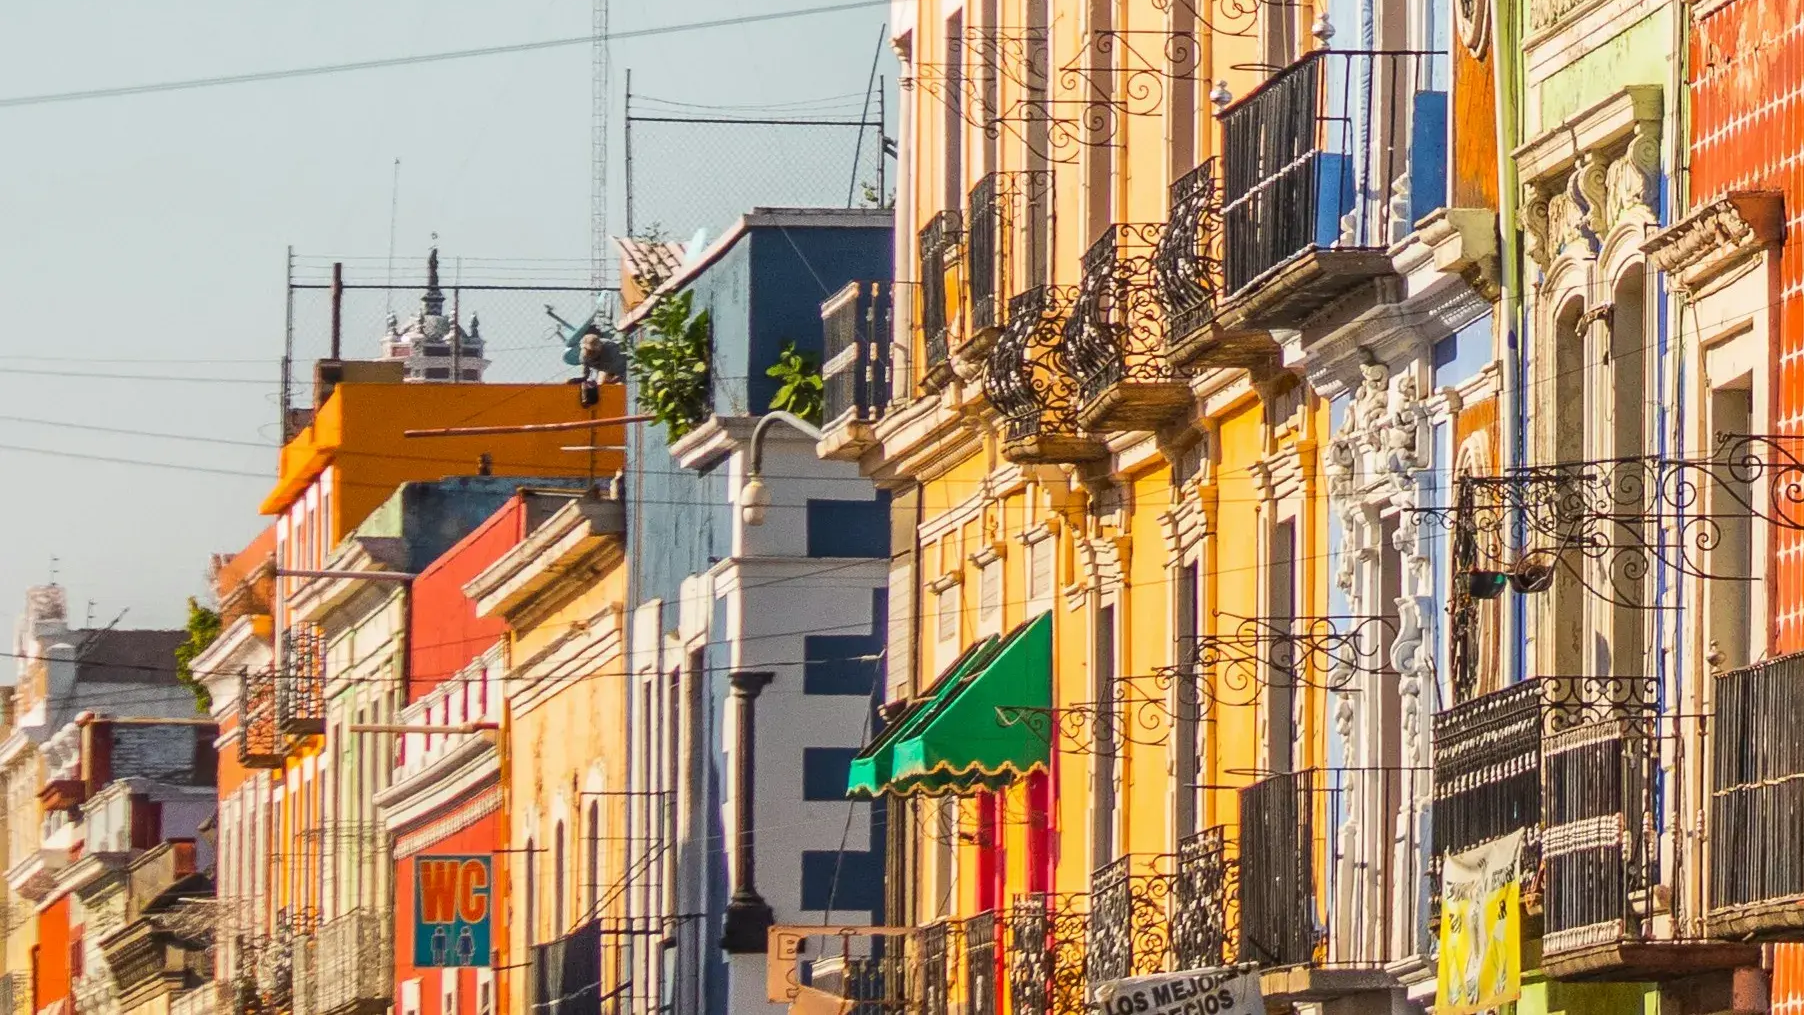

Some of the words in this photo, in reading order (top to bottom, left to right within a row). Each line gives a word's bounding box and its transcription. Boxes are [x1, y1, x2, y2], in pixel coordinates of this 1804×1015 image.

[419, 859, 488, 923] WC
[1104, 990, 1150, 1015] LOS
[1151, 969, 1238, 1008] MEJO
[1156, 988, 1236, 1015] CIOS
